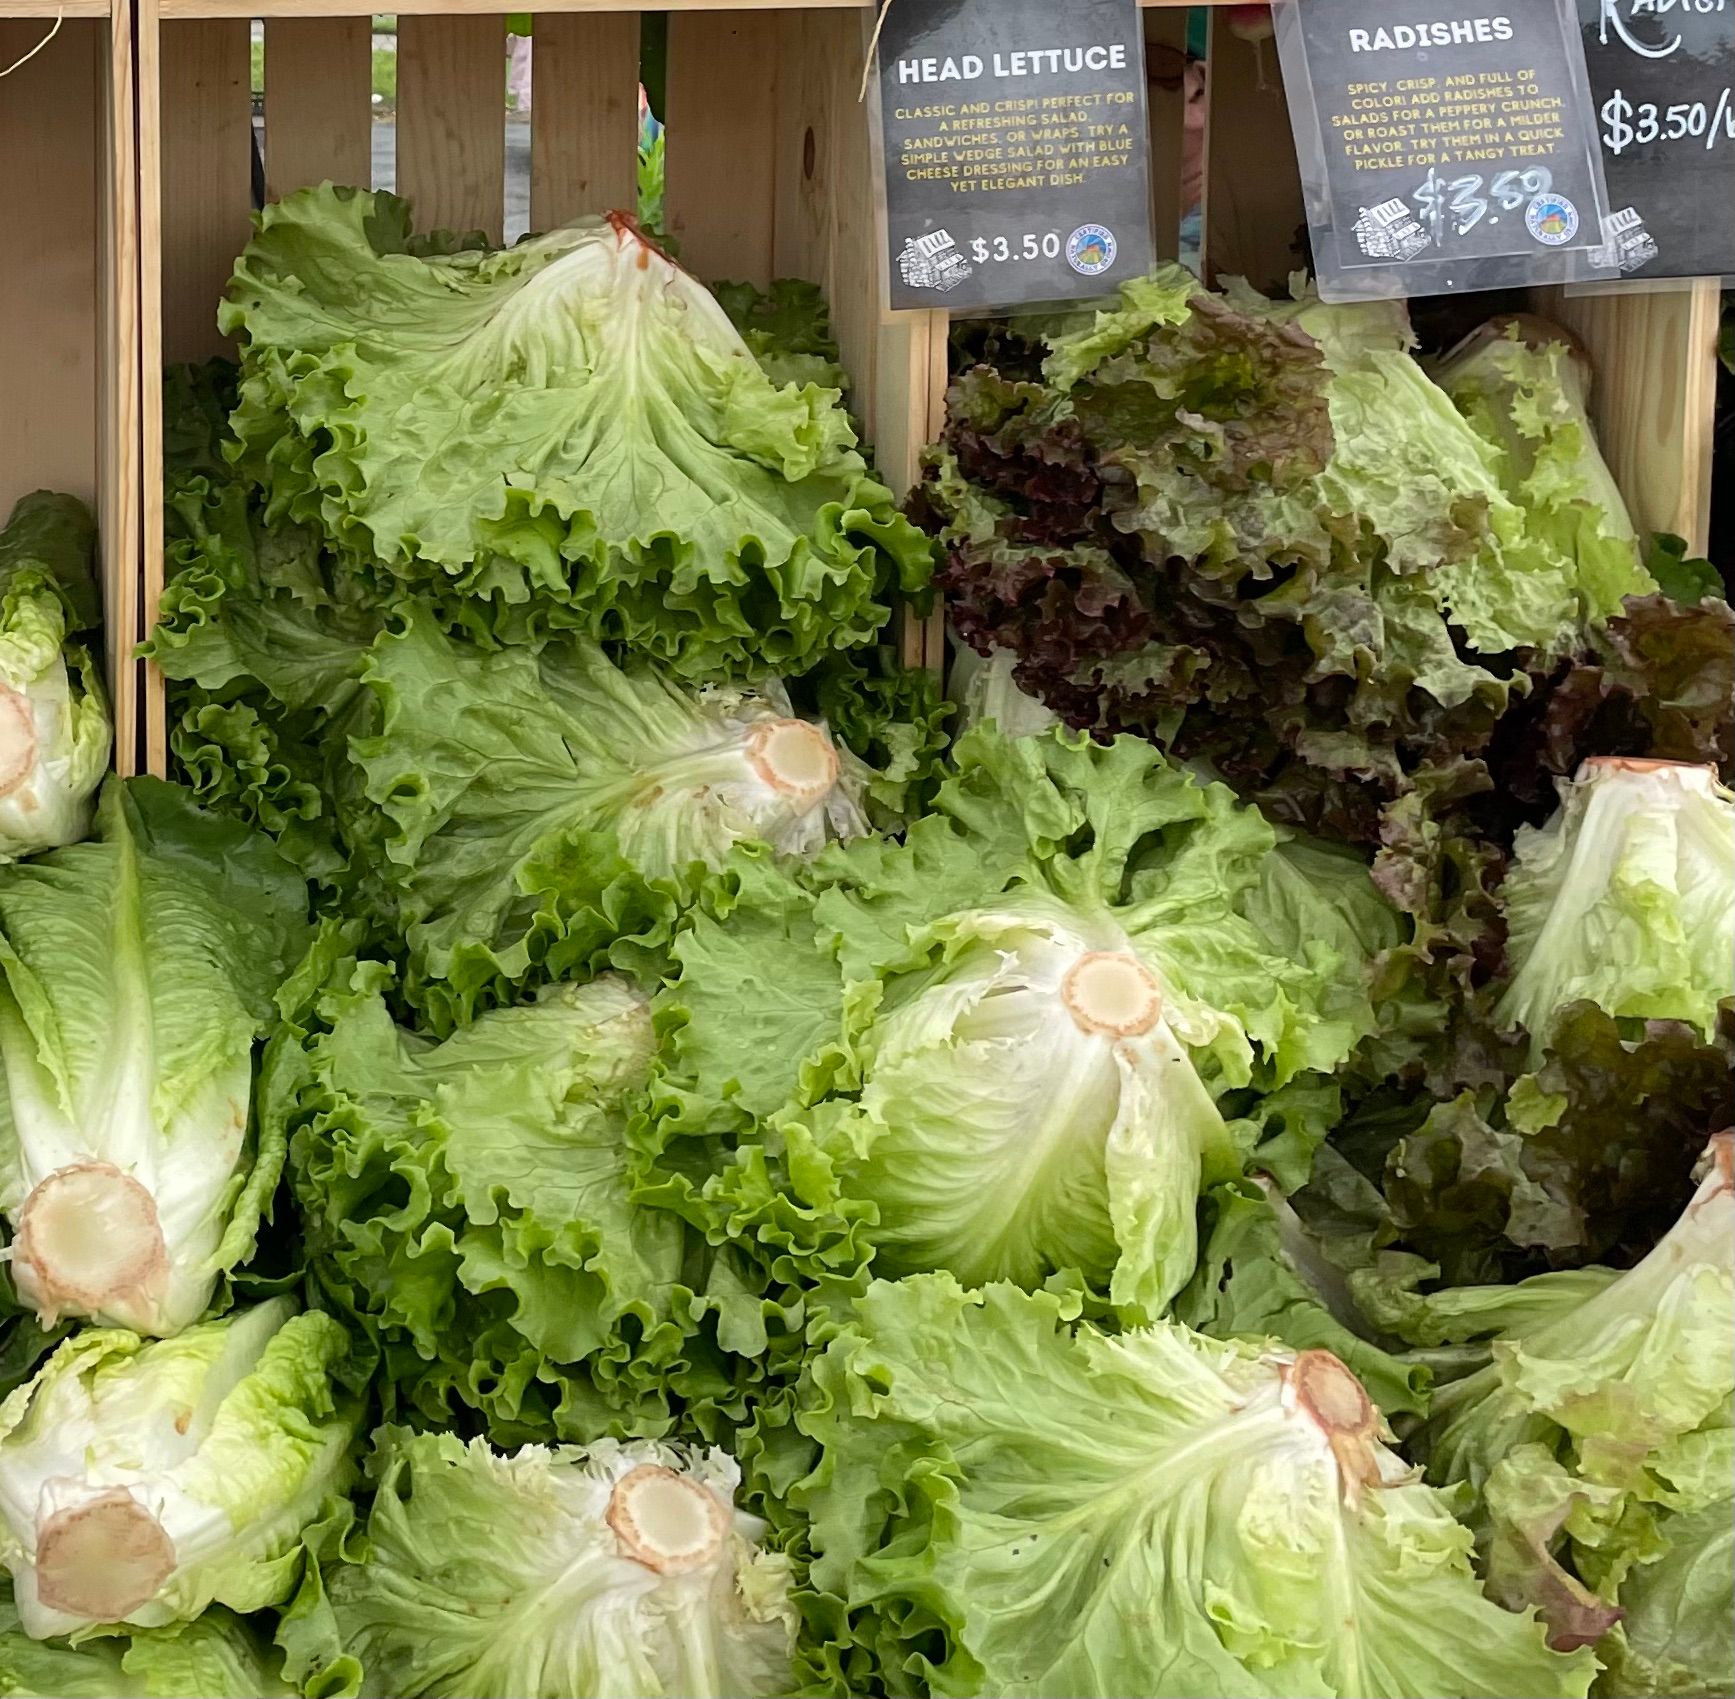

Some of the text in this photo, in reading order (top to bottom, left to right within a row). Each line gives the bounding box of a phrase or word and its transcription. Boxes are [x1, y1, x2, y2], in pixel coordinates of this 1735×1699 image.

[1349, 16, 1513, 52] RADISHES
[898, 45, 1127, 84] HEAD LETTUCE
[1446, 74, 1475, 87] AND
[1479, 71, 1513, 84] FULL
[1517, 69, 1536, 81] OF
[895, 105, 956, 119] CLASSIC
[960, 102, 990, 115] AND
[1042, 94, 1102, 109] PERFECT
[1106, 92, 1134, 104] FOR
[1411, 92, 1440, 104] ADD
[1444, 86, 1513, 101] RADISHES
[1517, 84, 1538, 95] TO
[939, 121, 949, 132] A
[952, 114, 1036, 131] REFRESHING
[1332, 112, 1389, 127] SALADS
[1392, 109, 1421, 121] FOR
[1425, 108, 1435, 119] A
[1439, 103, 1496, 117] PEPPERY
[1344, 112, 1560, 141] OR ROAST THEM FOR A MILDER
[1007, 131, 1026, 143] OR
[1088, 125, 1114, 137] TRY
[1119, 124, 1128, 135] A
[1410, 138, 1437, 150] TRY
[1442, 134, 1481, 147] THEM
[1484, 132, 1500, 144] IN
[1504, 132, 1515, 143] A
[1518, 128, 1564, 141] QUICK
[901, 138, 1133, 166] SIMPLE WEDGE SALAD WITH BLUE
[1355, 156, 1404, 170] PICKLE
[1408, 153, 1436, 165] FOR
[1441, 152, 1450, 163] A
[1454, 147, 1504, 162] TANGY
[906, 155, 1128, 180] CHEESE DRESSING FOR AN EASY
[950, 180, 977, 192] YET
[981, 175, 1045, 191] ELEGANT
[971, 233, 1060, 264] $3.50
